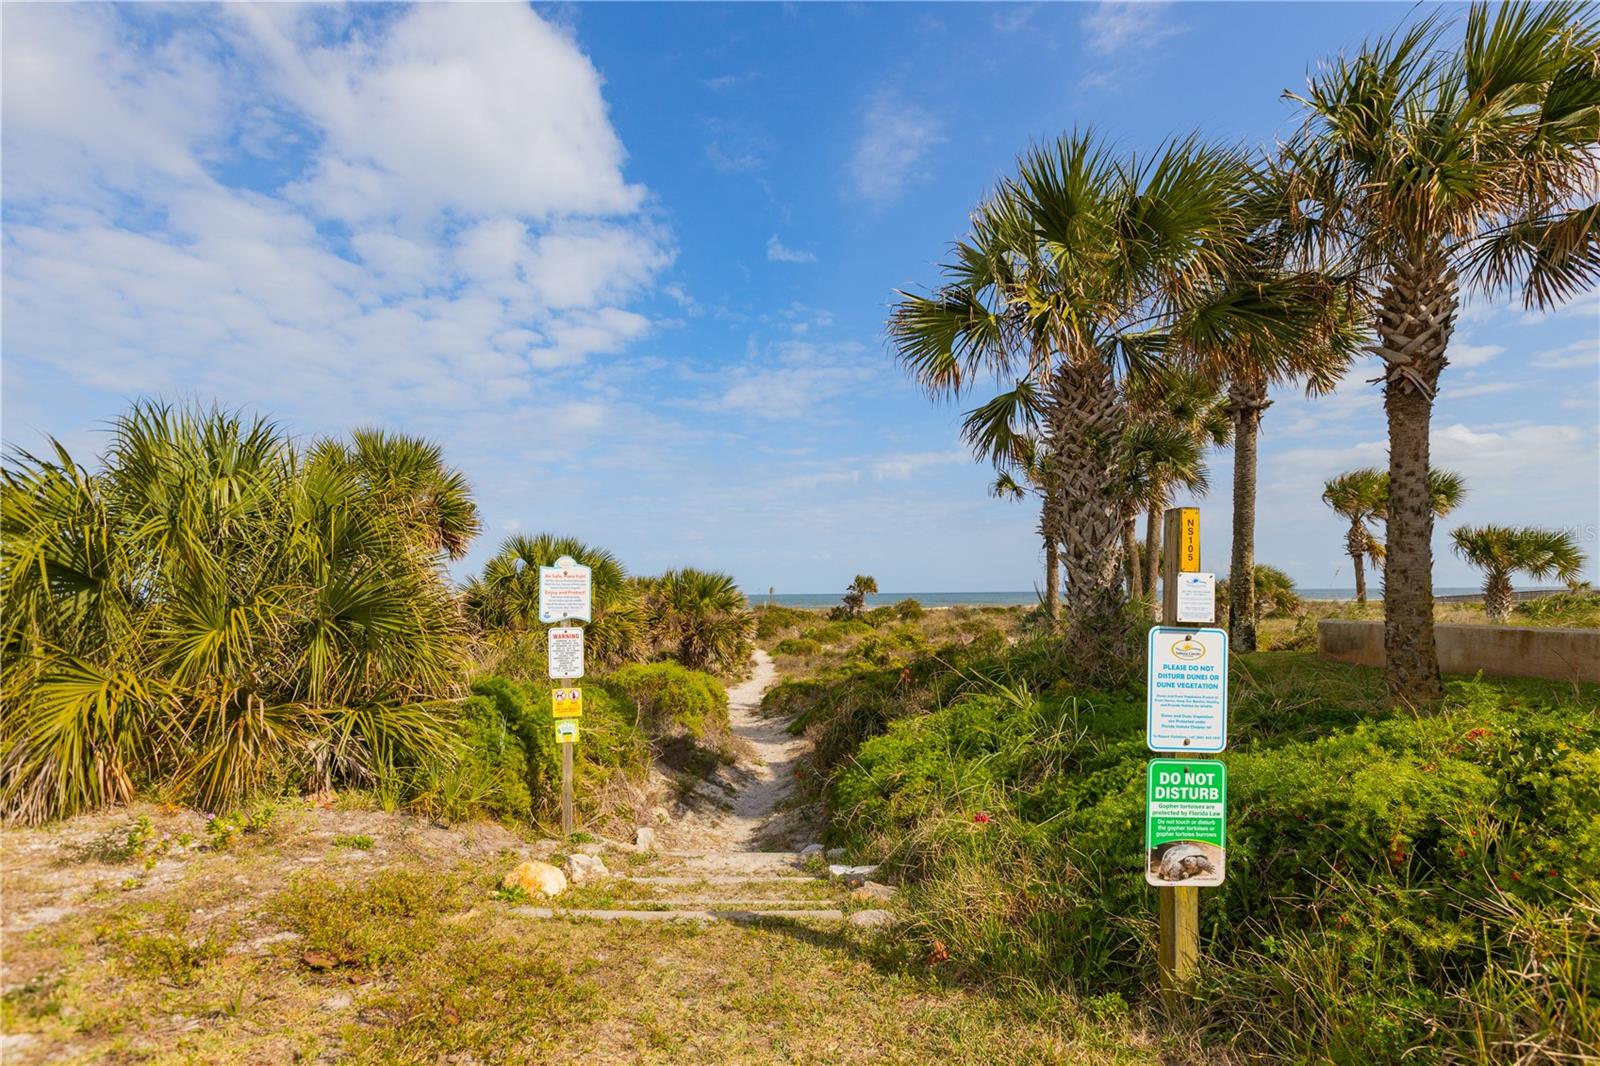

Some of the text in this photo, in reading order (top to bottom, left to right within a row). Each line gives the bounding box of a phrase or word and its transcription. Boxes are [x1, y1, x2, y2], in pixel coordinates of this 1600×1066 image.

[1177, 682, 1219, 690] VEGETATION
[1159, 772, 1216, 785] DO NOT
[1155, 786, 1219, 800] DISTURB
